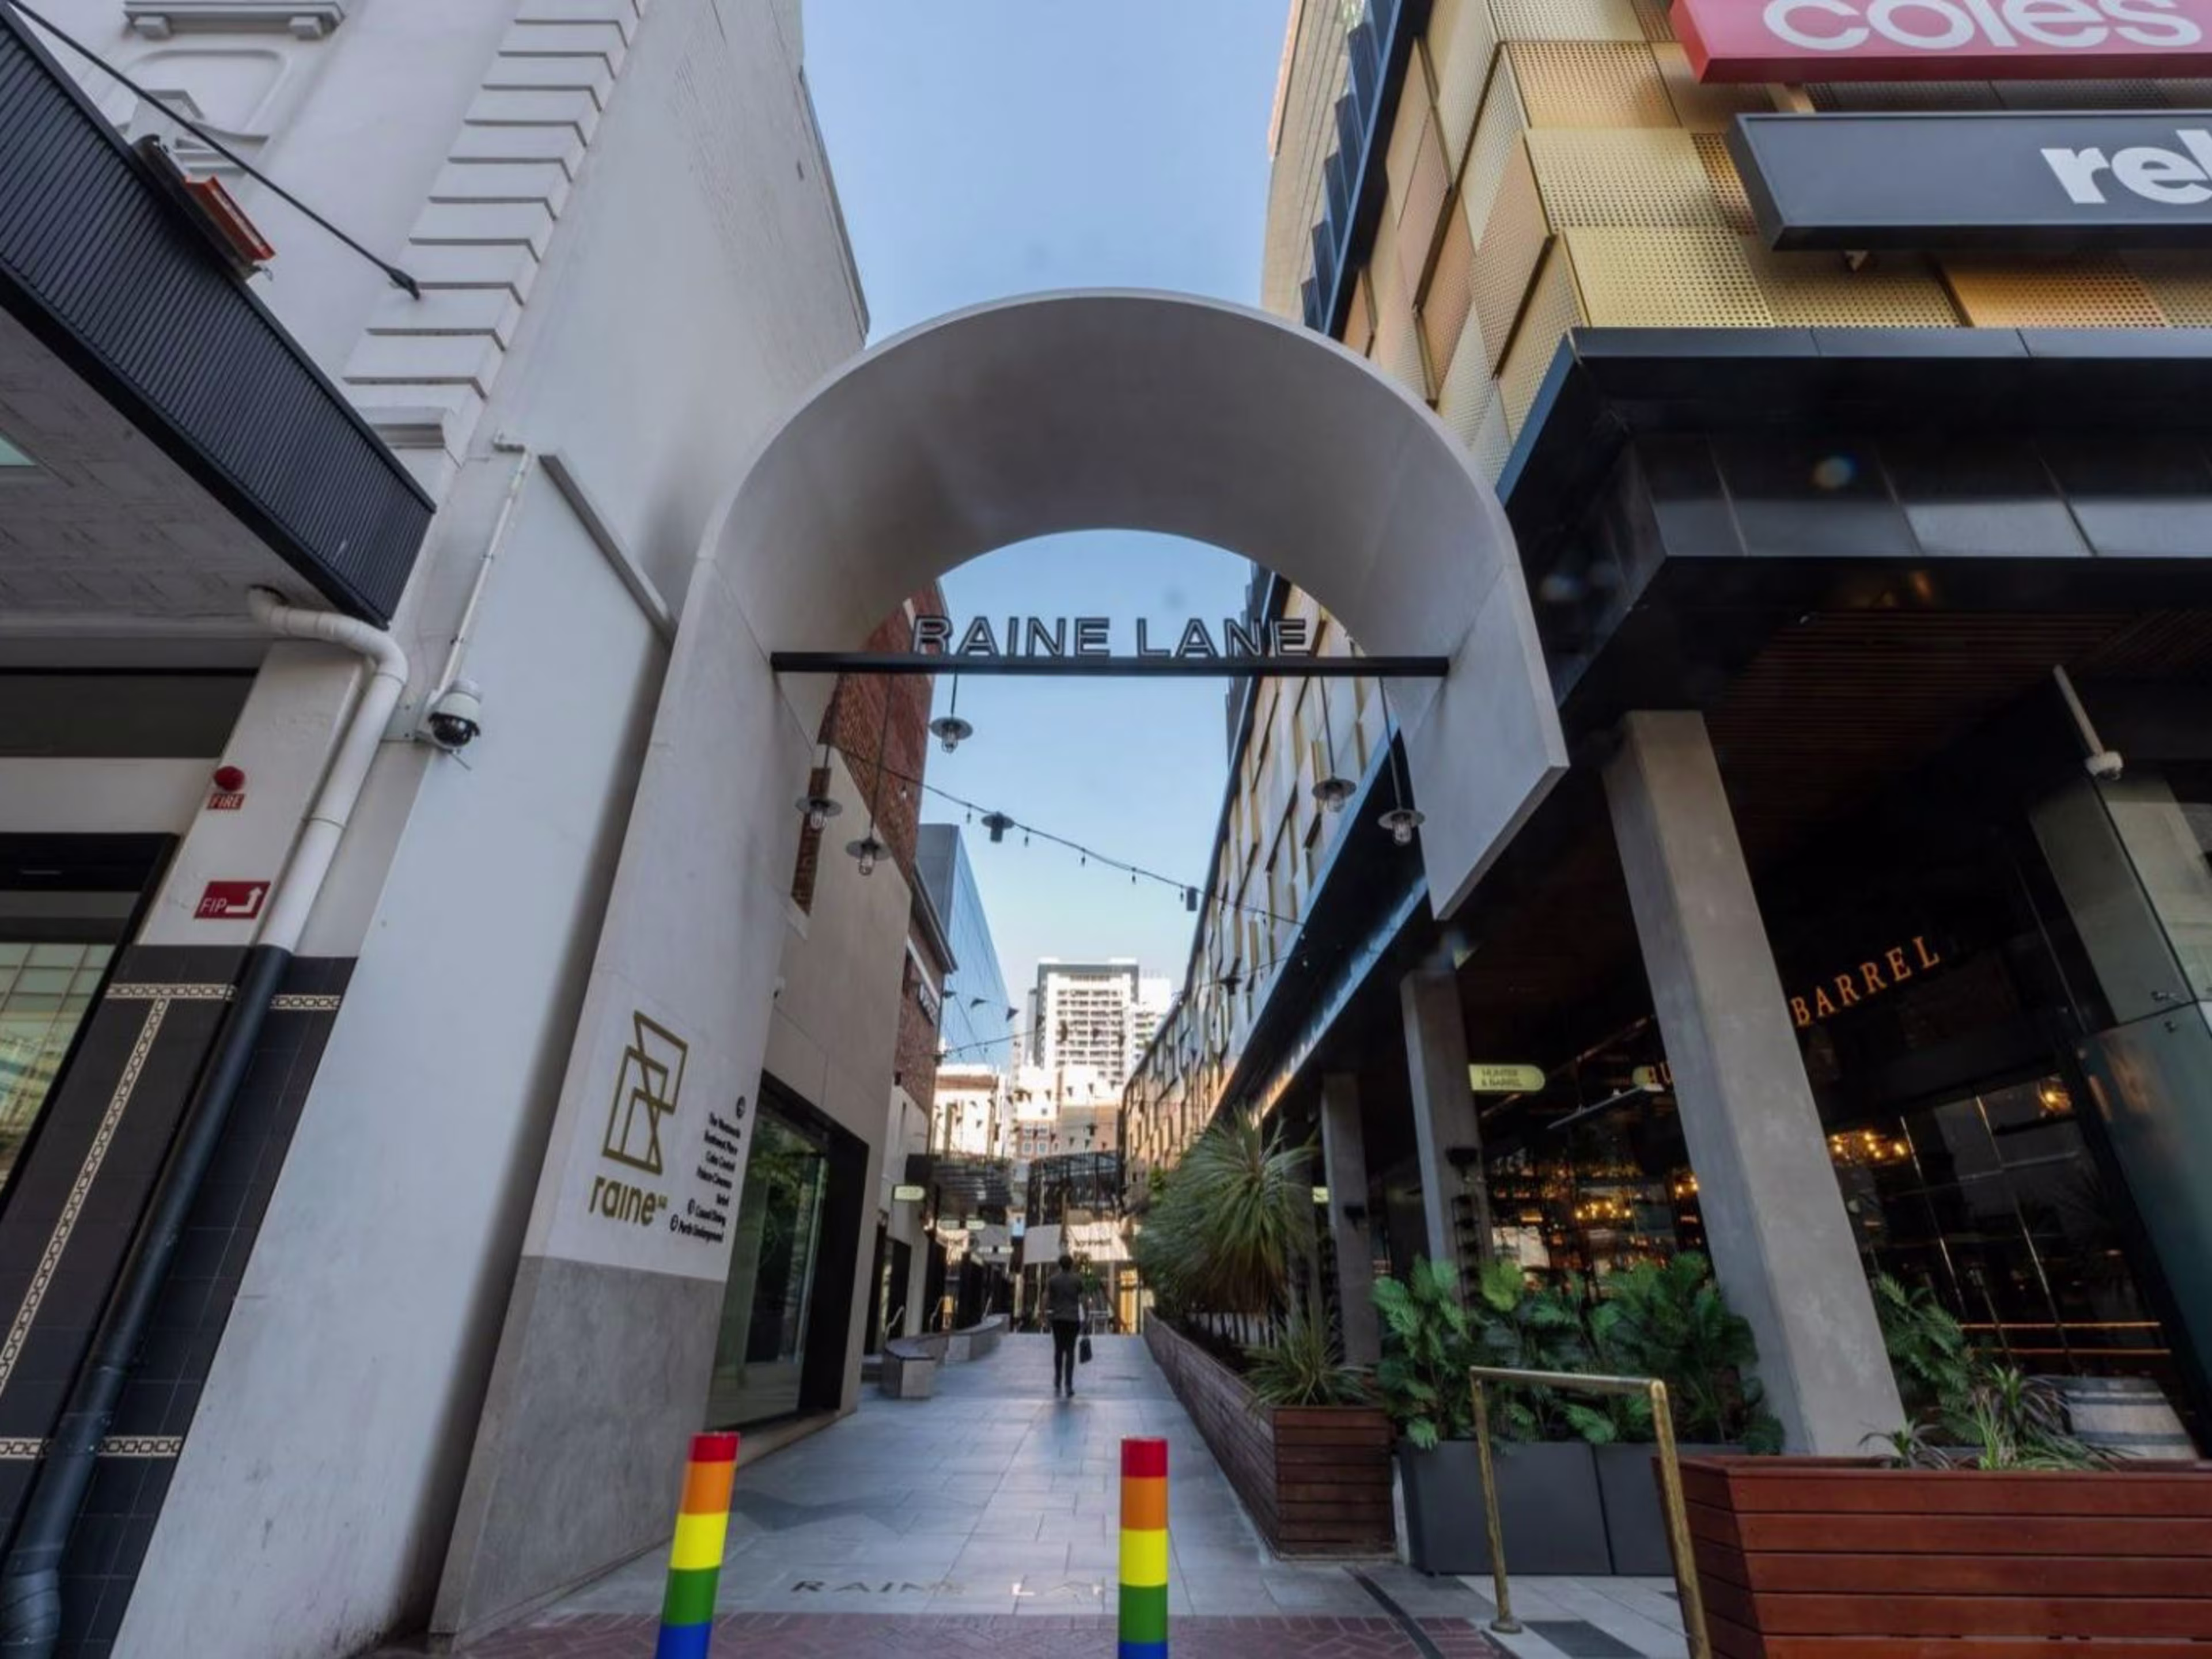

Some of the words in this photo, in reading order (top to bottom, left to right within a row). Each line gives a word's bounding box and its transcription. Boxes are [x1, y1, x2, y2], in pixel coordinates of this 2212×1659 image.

[1763, 0, 2202, 50] coles
[914, 616, 1110, 658] RAINE
[1136, 618, 1312, 658] LANE
[210, 794, 243, 807] FIRE
[199, 897, 228, 913] FIP
[1790, 935, 1940, 1027] BARREL
[589, 1175, 656, 1226] raine
